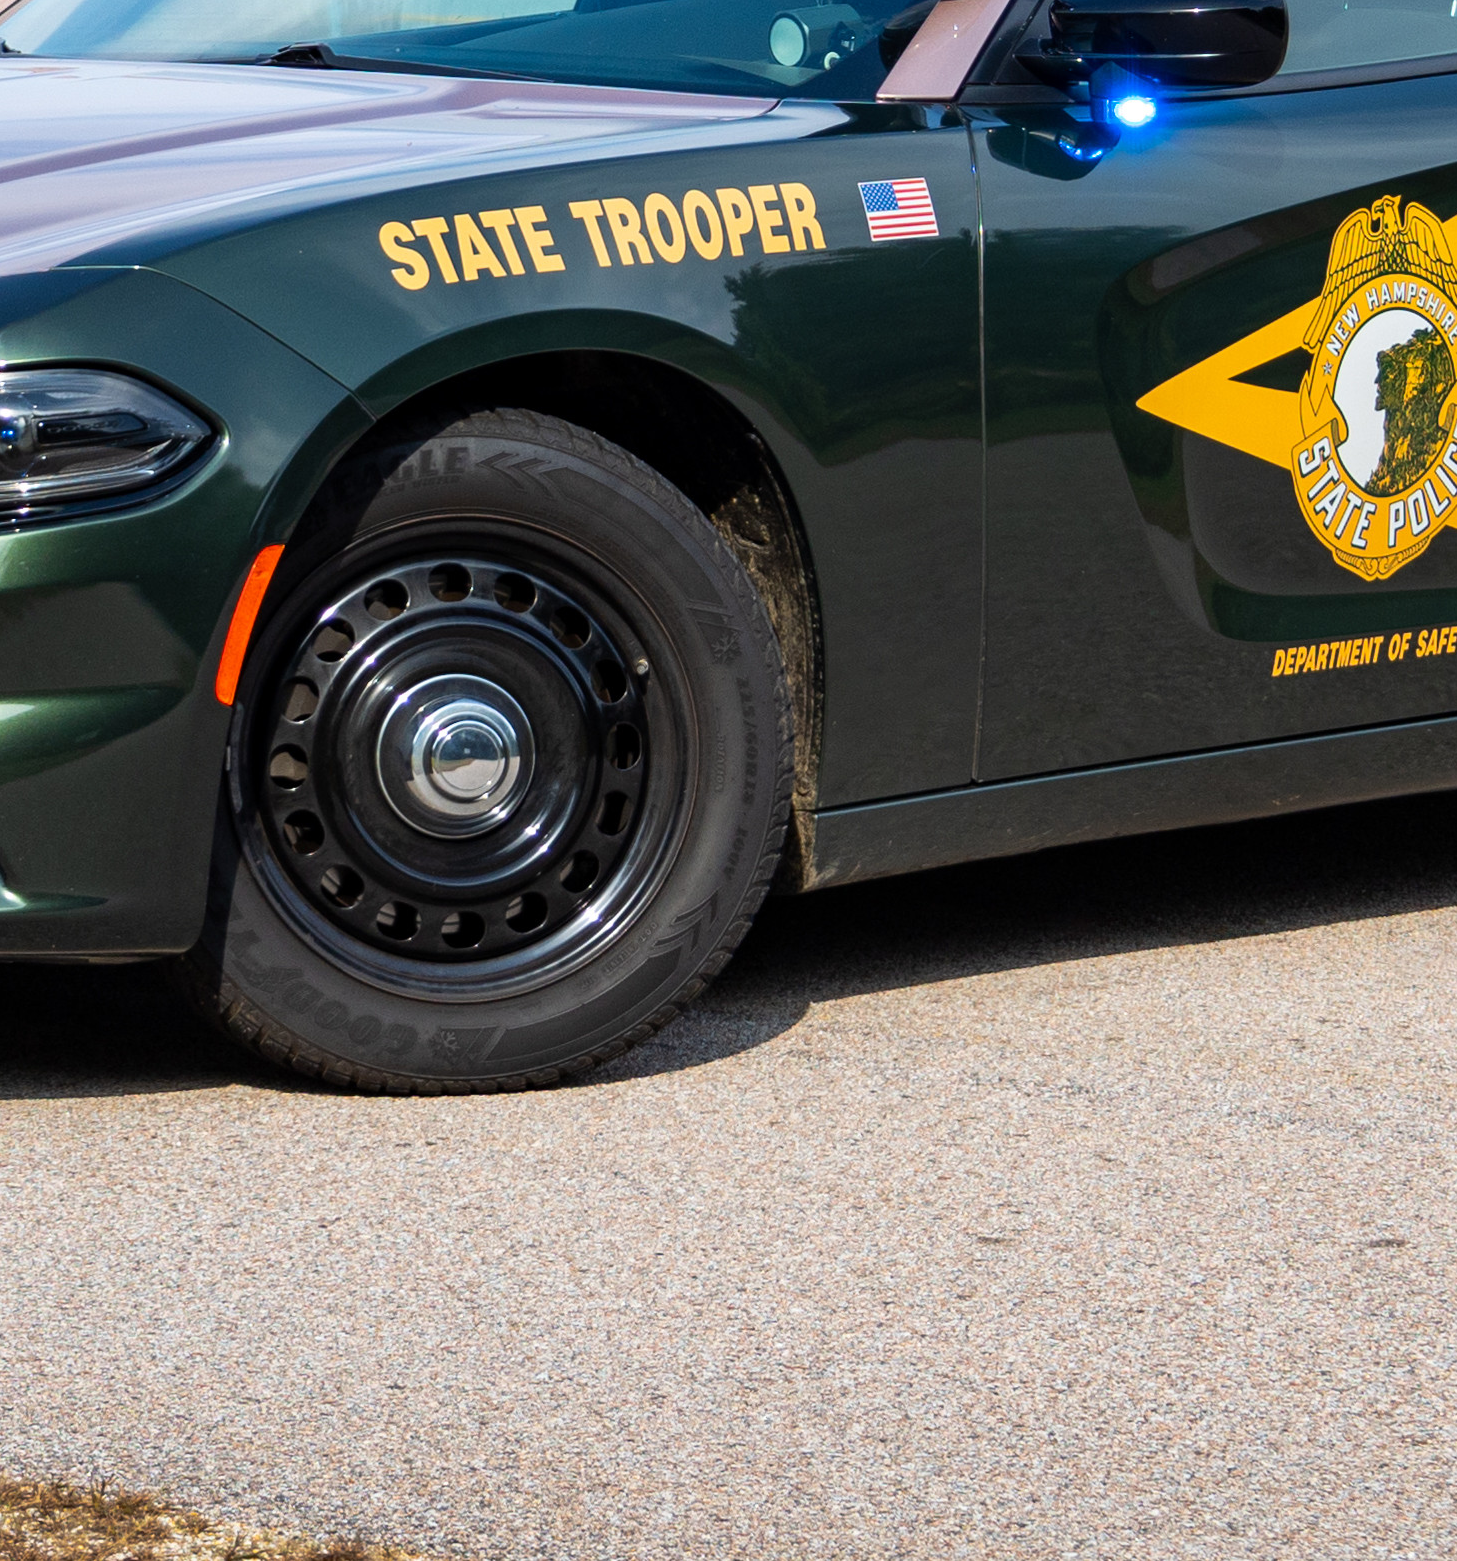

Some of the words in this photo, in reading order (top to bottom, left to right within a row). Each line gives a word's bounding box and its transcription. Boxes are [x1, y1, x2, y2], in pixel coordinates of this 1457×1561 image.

[378, 206, 564, 291] STATE
[569, 185, 826, 268] TROOPER
[1325, 304, 1360, 357] NEW
[1299, 437, 1376, 548] STATE
[1271, 635, 1385, 679] DEPARTMENT
[1387, 631, 1413, 662] OF
